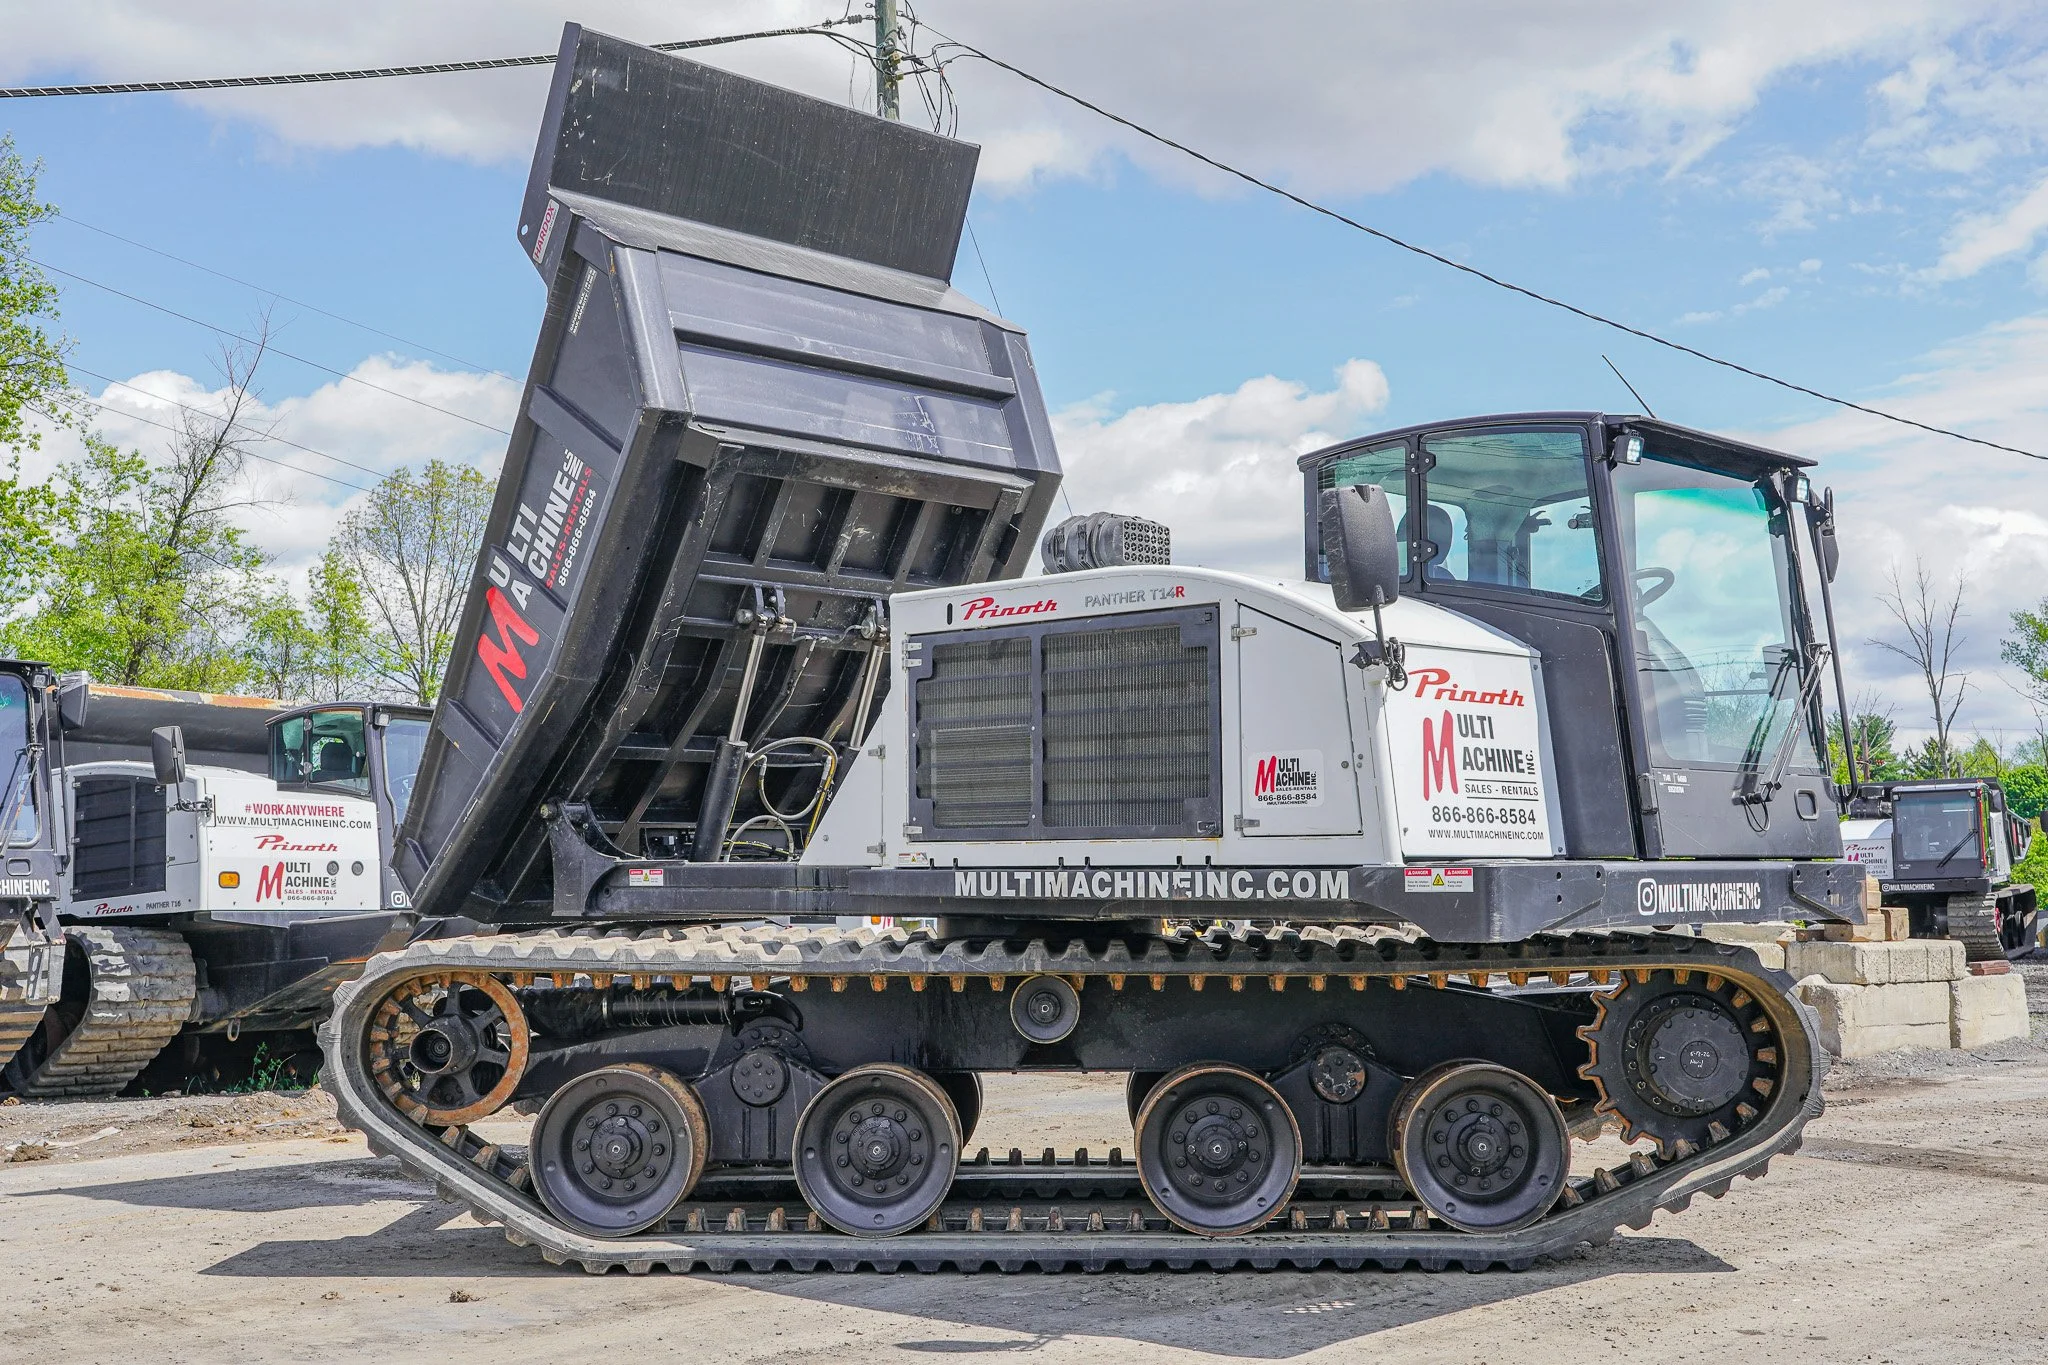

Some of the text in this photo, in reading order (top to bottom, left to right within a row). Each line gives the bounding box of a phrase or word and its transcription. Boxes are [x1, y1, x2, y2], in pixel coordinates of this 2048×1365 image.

[533, 205, 554, 258] HARDOX
[558, 489, 596, 587] 866-866-8584
[1084, 586, 1185, 607] PANTHER T14R
[961, 597, 1057, 620] Prinoth
[1408, 668, 1524, 707] Prinoth
[1258, 793, 1317, 801] 866-866-8584
[1465, 784, 1492, 794] SALES
[1501, 785, 1539, 796] RENTALS
[245, 803, 344, 817] #WORKANYWHERE
[1432, 806, 1536, 824] 866-866-8584
[217, 816, 372, 829] WWW.MULTIMACHINEINC.COM
[254, 834, 338, 852] Prinoth
[1428, 829, 1544, 840] WWW.MULTIMACHINEINC.COM
[0, 879, 50, 895] HINEINC
[953, 871, 1350, 900] MULTIMACHINEINC.COM
[1658, 882, 1761, 913] MULTIMACHINEINC
[94, 903, 133, 915] Prinoth
